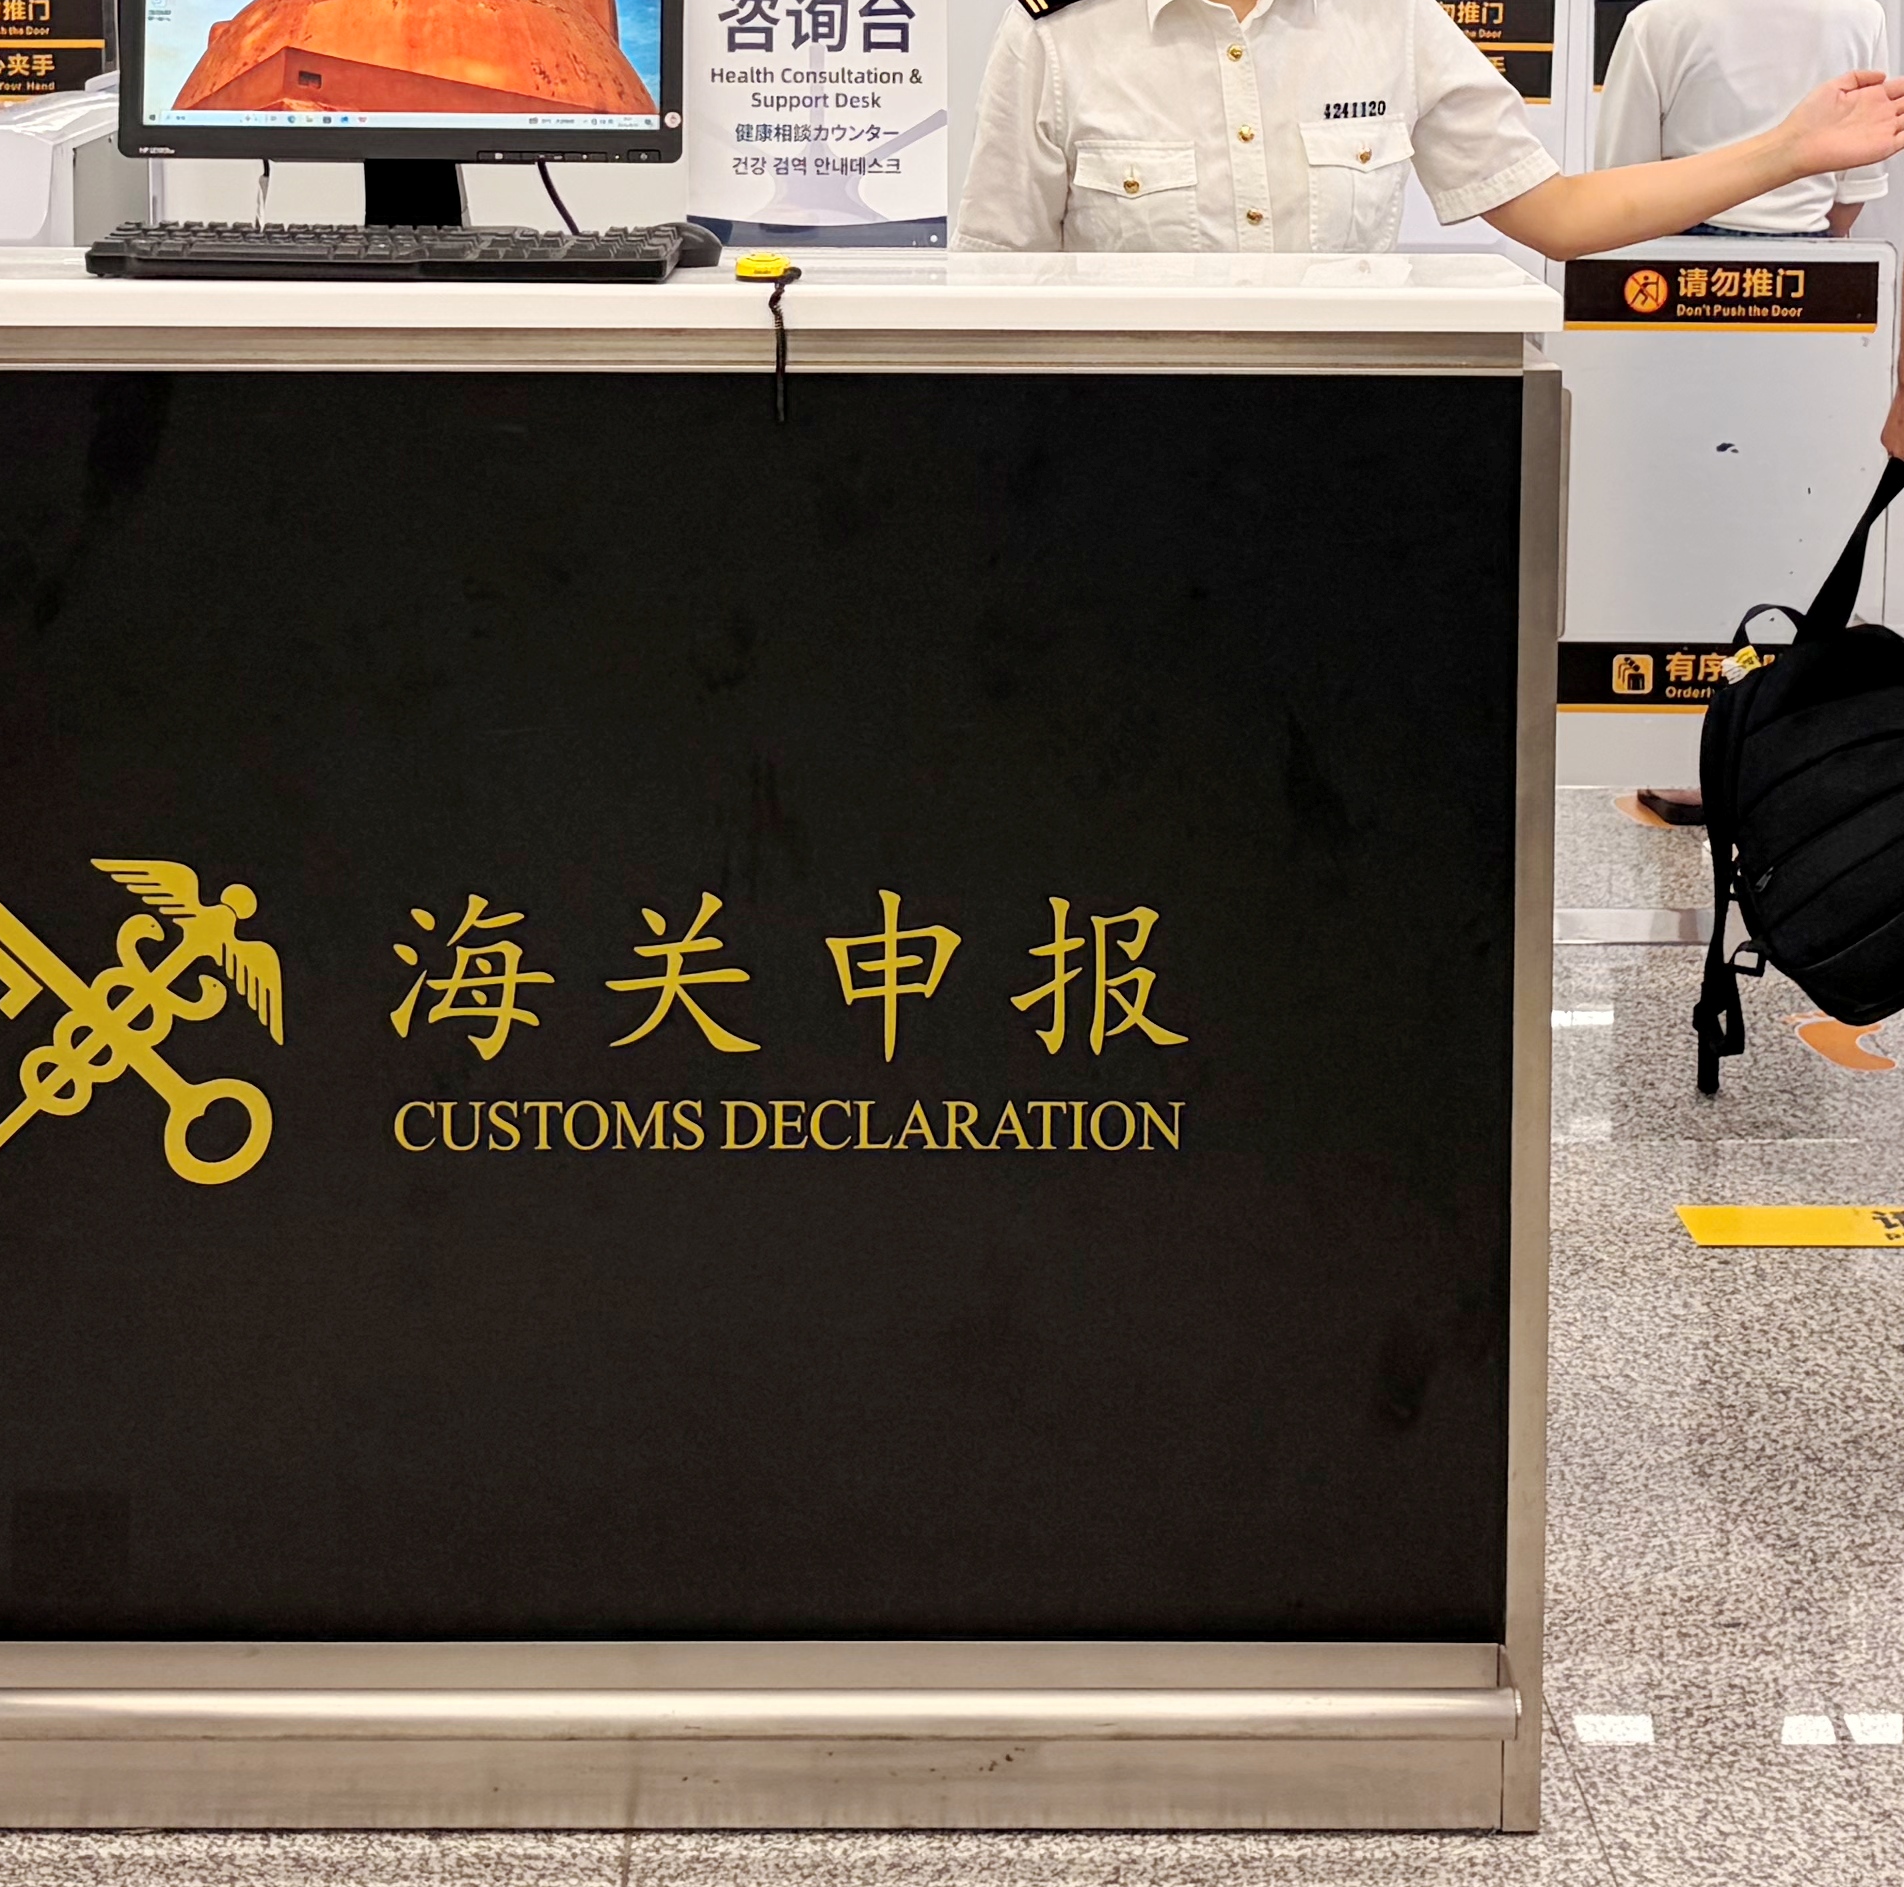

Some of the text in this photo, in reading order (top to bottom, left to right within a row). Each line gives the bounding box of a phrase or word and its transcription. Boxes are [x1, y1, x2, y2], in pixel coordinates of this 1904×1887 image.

[8, 26, 25, 37] the
[26, 26, 51, 37] Door
[1478, 28, 1503, 40] Door
[710, 67, 924, 85] Health Consultation &
[26, 81, 56, 92] Hand
[751, 92, 882, 112] Support Desk
[735, 123, 900, 143] 健康相談カウンター
[732, 156, 902, 176] 건강 검역 안내데스크
[1677, 267, 1806, 299] 请勿推门
[1676, 303, 1804, 318] Don't Push the Door
[1665, 651, 1726, 683] 有序
[1665, 685, 1715, 699] Orderl
[389, 889, 1190, 1062] 海关申报
[393, 1098, 1188, 1153] CUSTOMS DECLARATION
